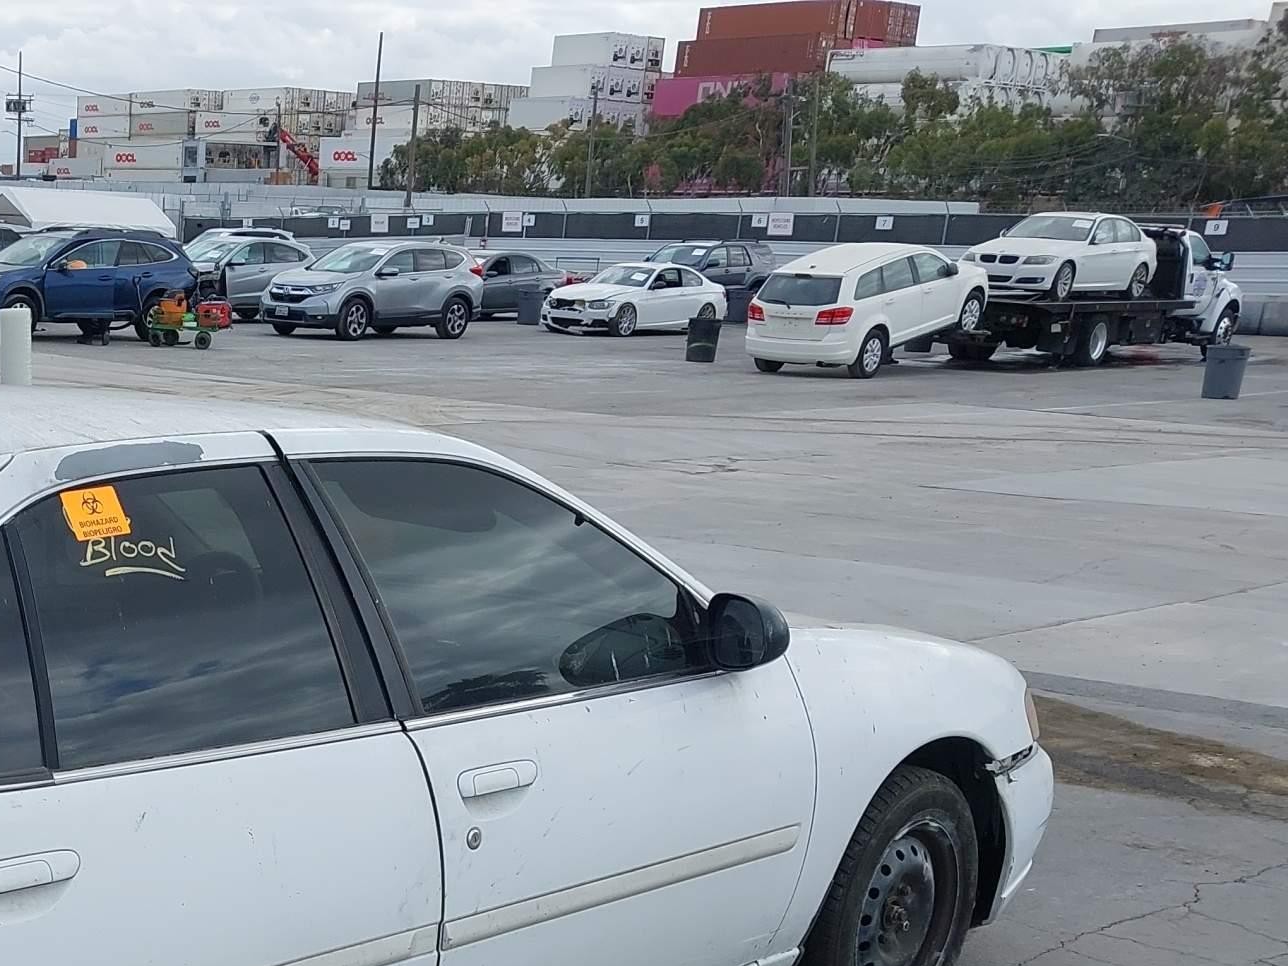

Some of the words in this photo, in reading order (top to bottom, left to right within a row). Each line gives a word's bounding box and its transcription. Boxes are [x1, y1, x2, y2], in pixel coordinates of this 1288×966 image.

[204, 120, 220, 128] OOCL
[115, 153, 136, 162] OOCL
[333, 151, 357, 161] OOCL
[78, 516, 119, 529] BIOHAZARD
[82, 526, 123, 538] BIOPELIGRO
